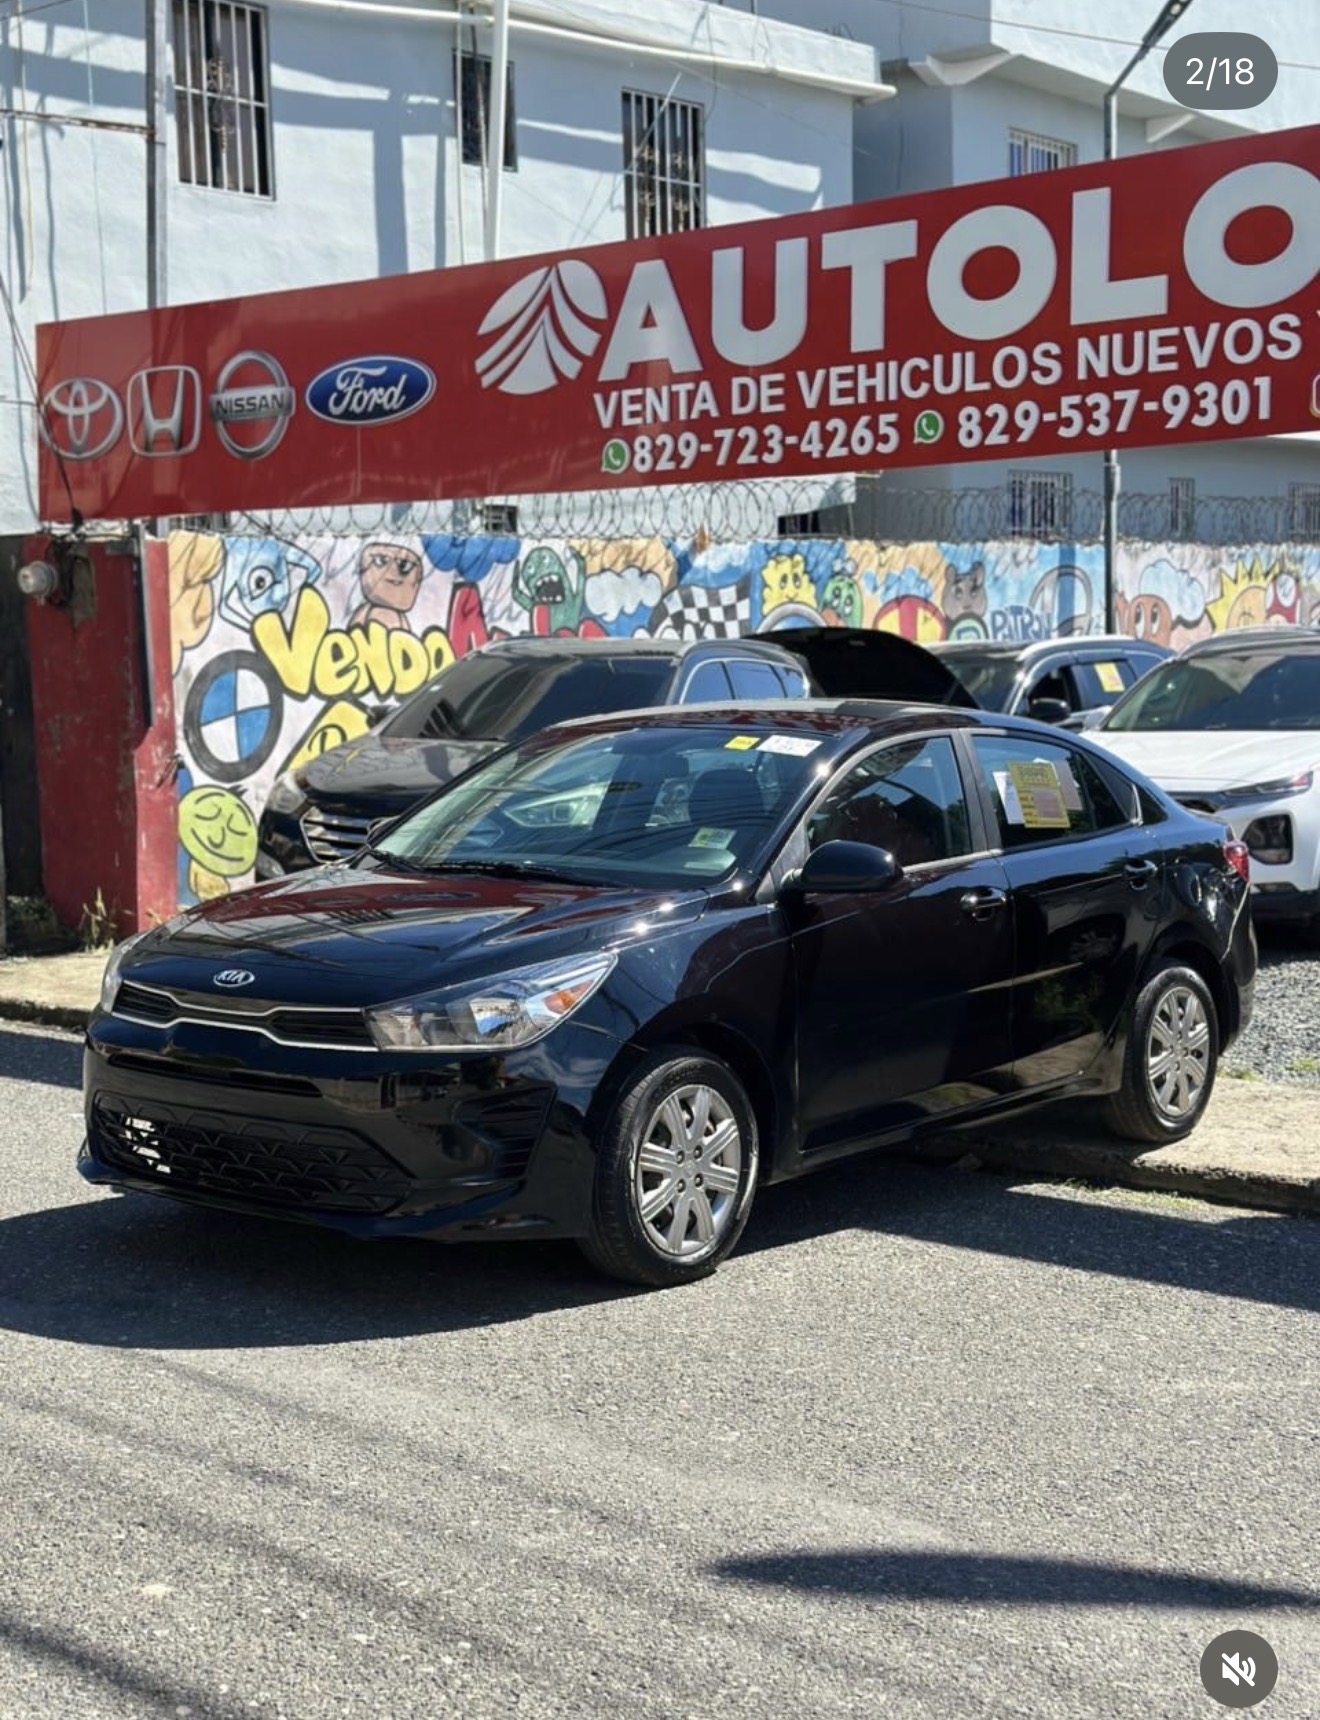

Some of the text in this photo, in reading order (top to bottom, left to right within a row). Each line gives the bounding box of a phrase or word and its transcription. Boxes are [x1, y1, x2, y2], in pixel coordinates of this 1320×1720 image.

[598, 162, 1320, 382] AUTOLO
[328, 365, 408, 414] Ford
[594, 313, 1303, 429] VENTA DE VEHICULOS NUEVOS
[215, 393, 285, 414] NISSAN
[958, 376, 1272, 449] 829-537-9301
[633, 412, 899, 473] 829-723-4265
[217, 970, 246, 984] KIA
